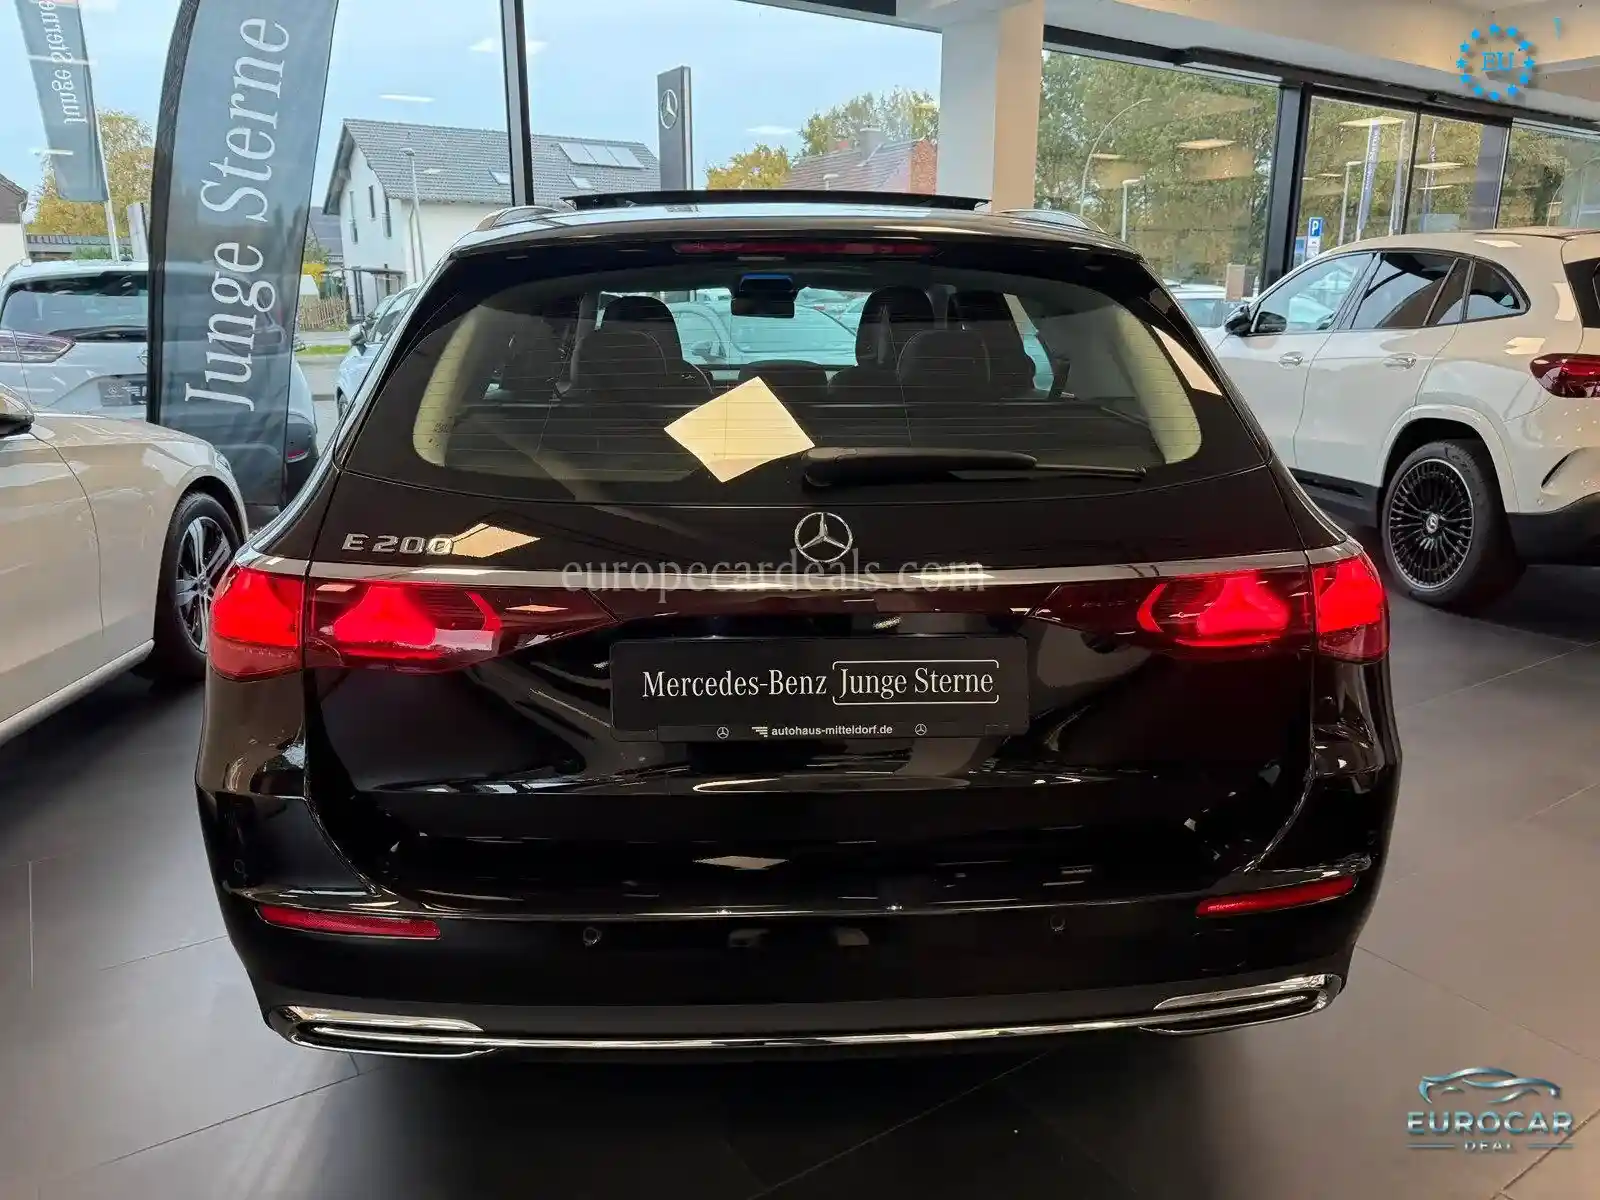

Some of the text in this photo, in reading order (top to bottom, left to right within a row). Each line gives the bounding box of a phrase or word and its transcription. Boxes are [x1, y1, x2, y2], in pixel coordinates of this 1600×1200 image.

[184, 17, 290, 412] Junge Sterne
[1311, 220, 1320, 236] P
[342, 533, 454, 555] E 200
[642, 667, 994, 699] Mercedes-Benz Junge Sterne
[771, 725, 893, 736] autohaus-mitteldorf.de
